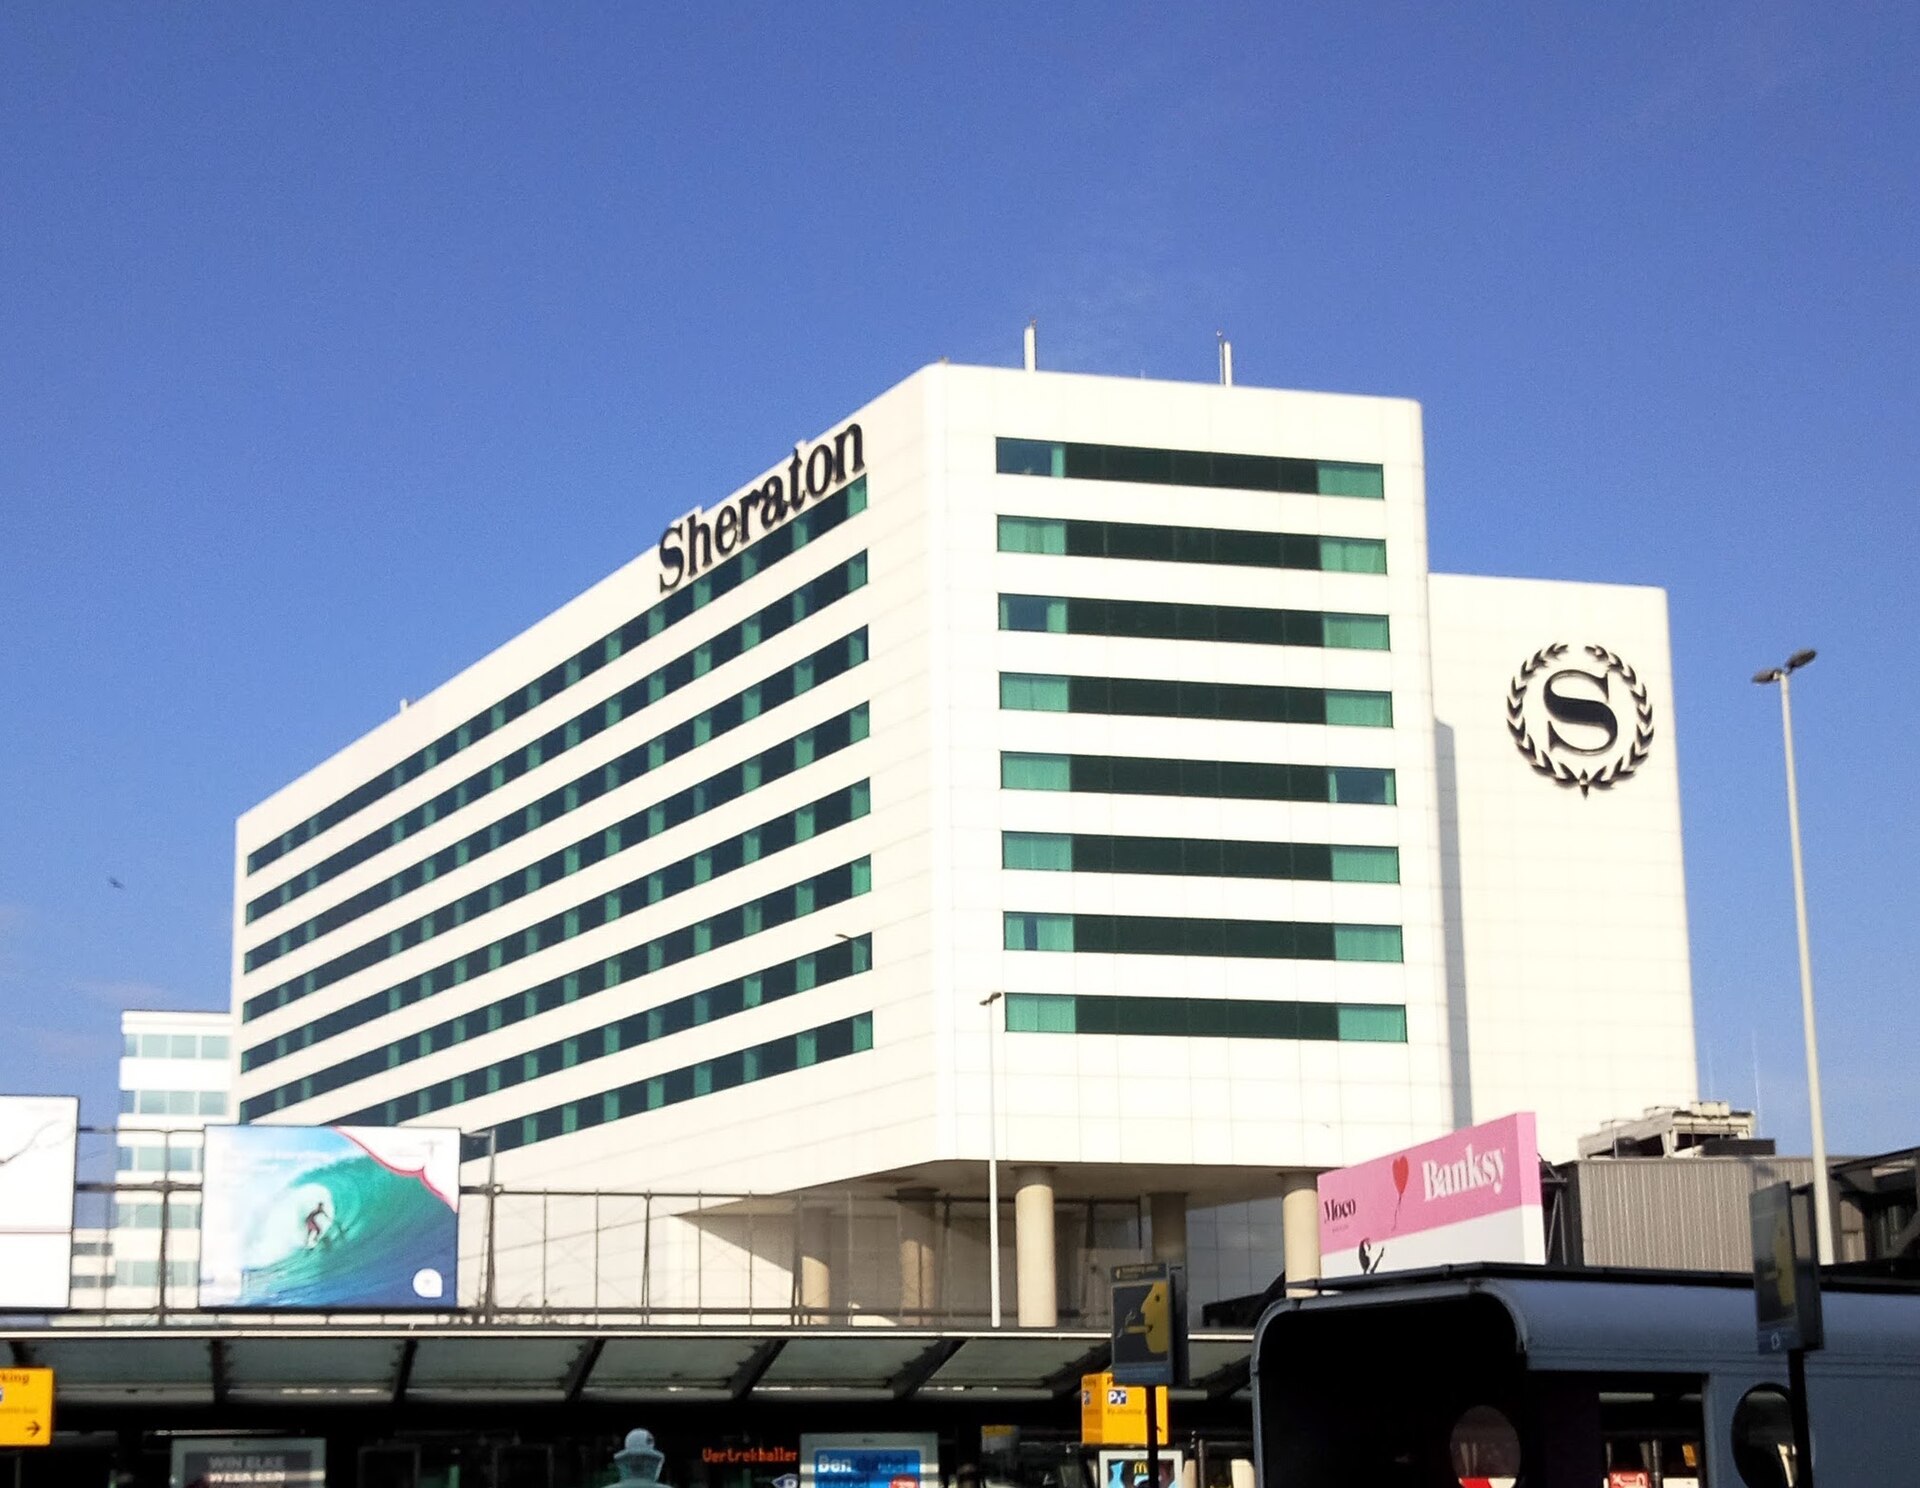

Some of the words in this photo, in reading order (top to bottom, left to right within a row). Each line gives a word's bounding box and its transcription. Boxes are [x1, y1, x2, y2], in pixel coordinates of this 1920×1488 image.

[659, 423, 865, 593] Sheraton
[1543, 669, 1618, 756] S
[1421, 1143, 1506, 1201] Banksy
[1324, 1198, 1357, 1225] Moco
[0, 1373, 30, 1386] king
